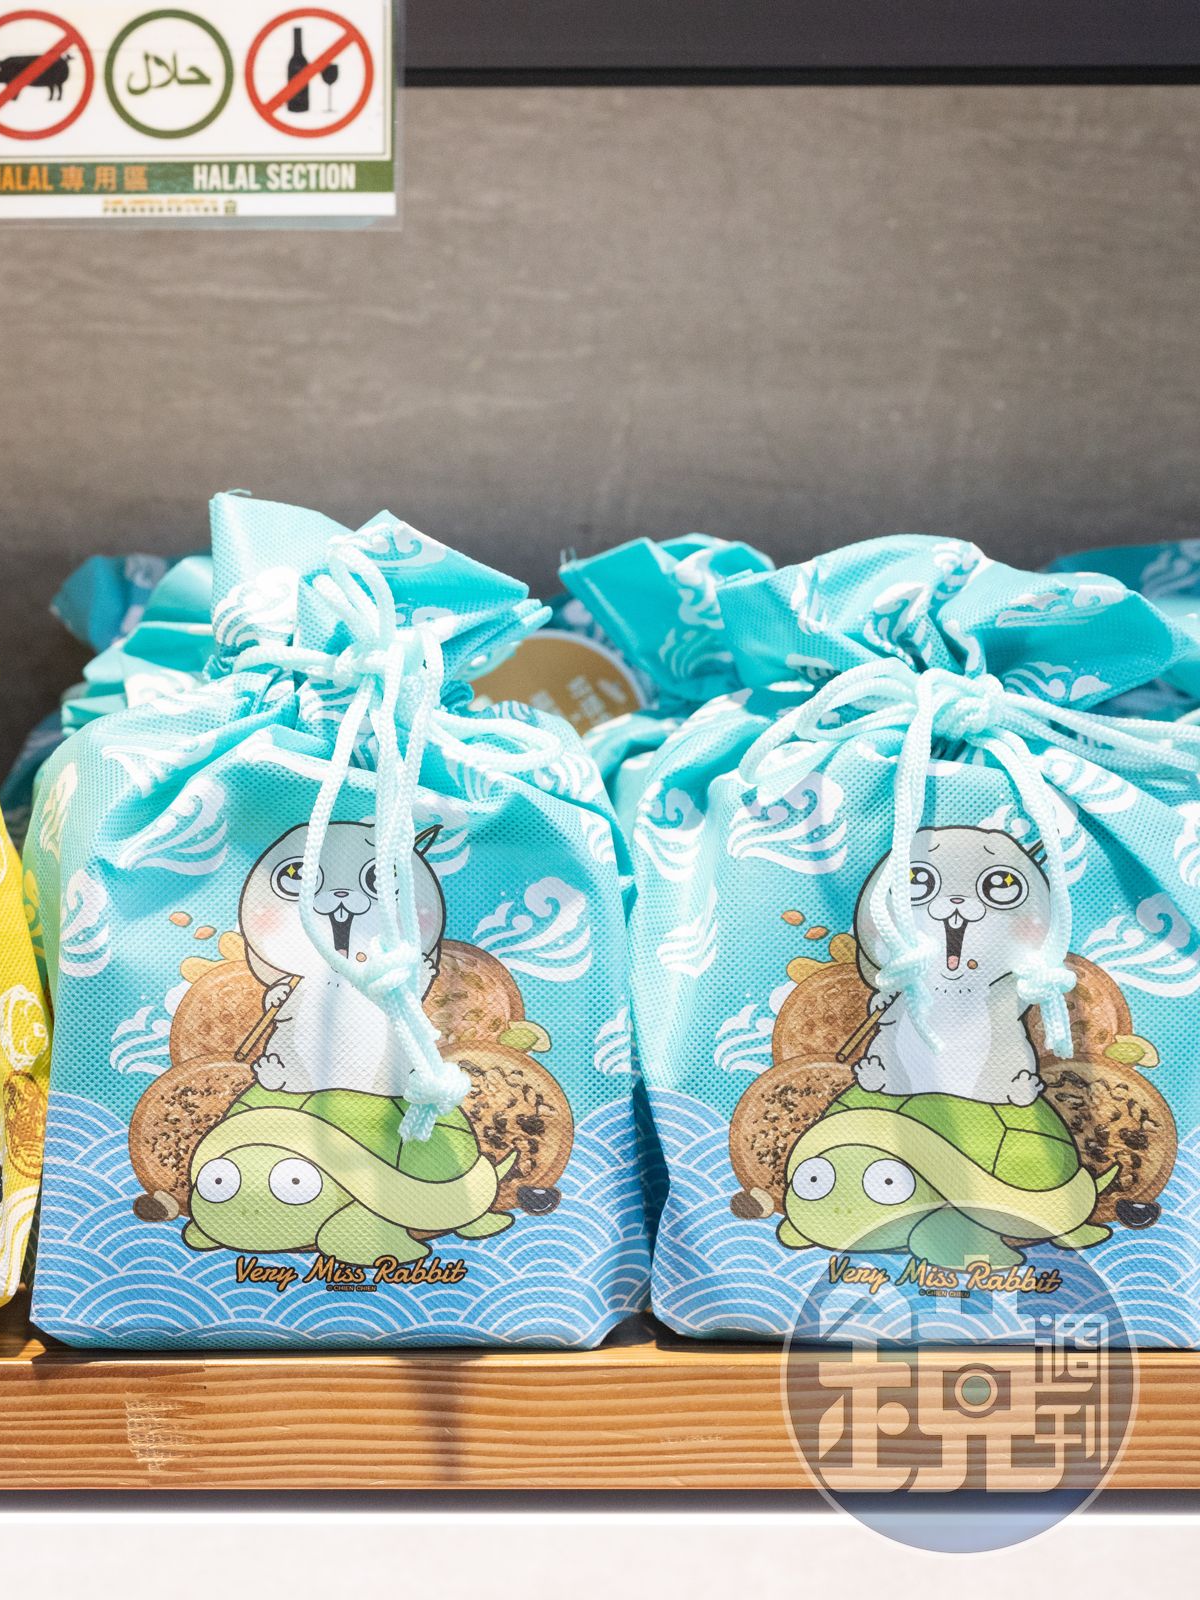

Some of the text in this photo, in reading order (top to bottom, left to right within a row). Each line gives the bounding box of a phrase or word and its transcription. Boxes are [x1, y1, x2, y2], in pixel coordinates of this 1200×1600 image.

[127, 51, 211, 95] حلال
[193, 162, 356, 190] HALAL SECTION
[236, 1255, 468, 1292] Very Miss Rabbit
[828, 1256, 1063, 1295] Very Miss Rabbit
